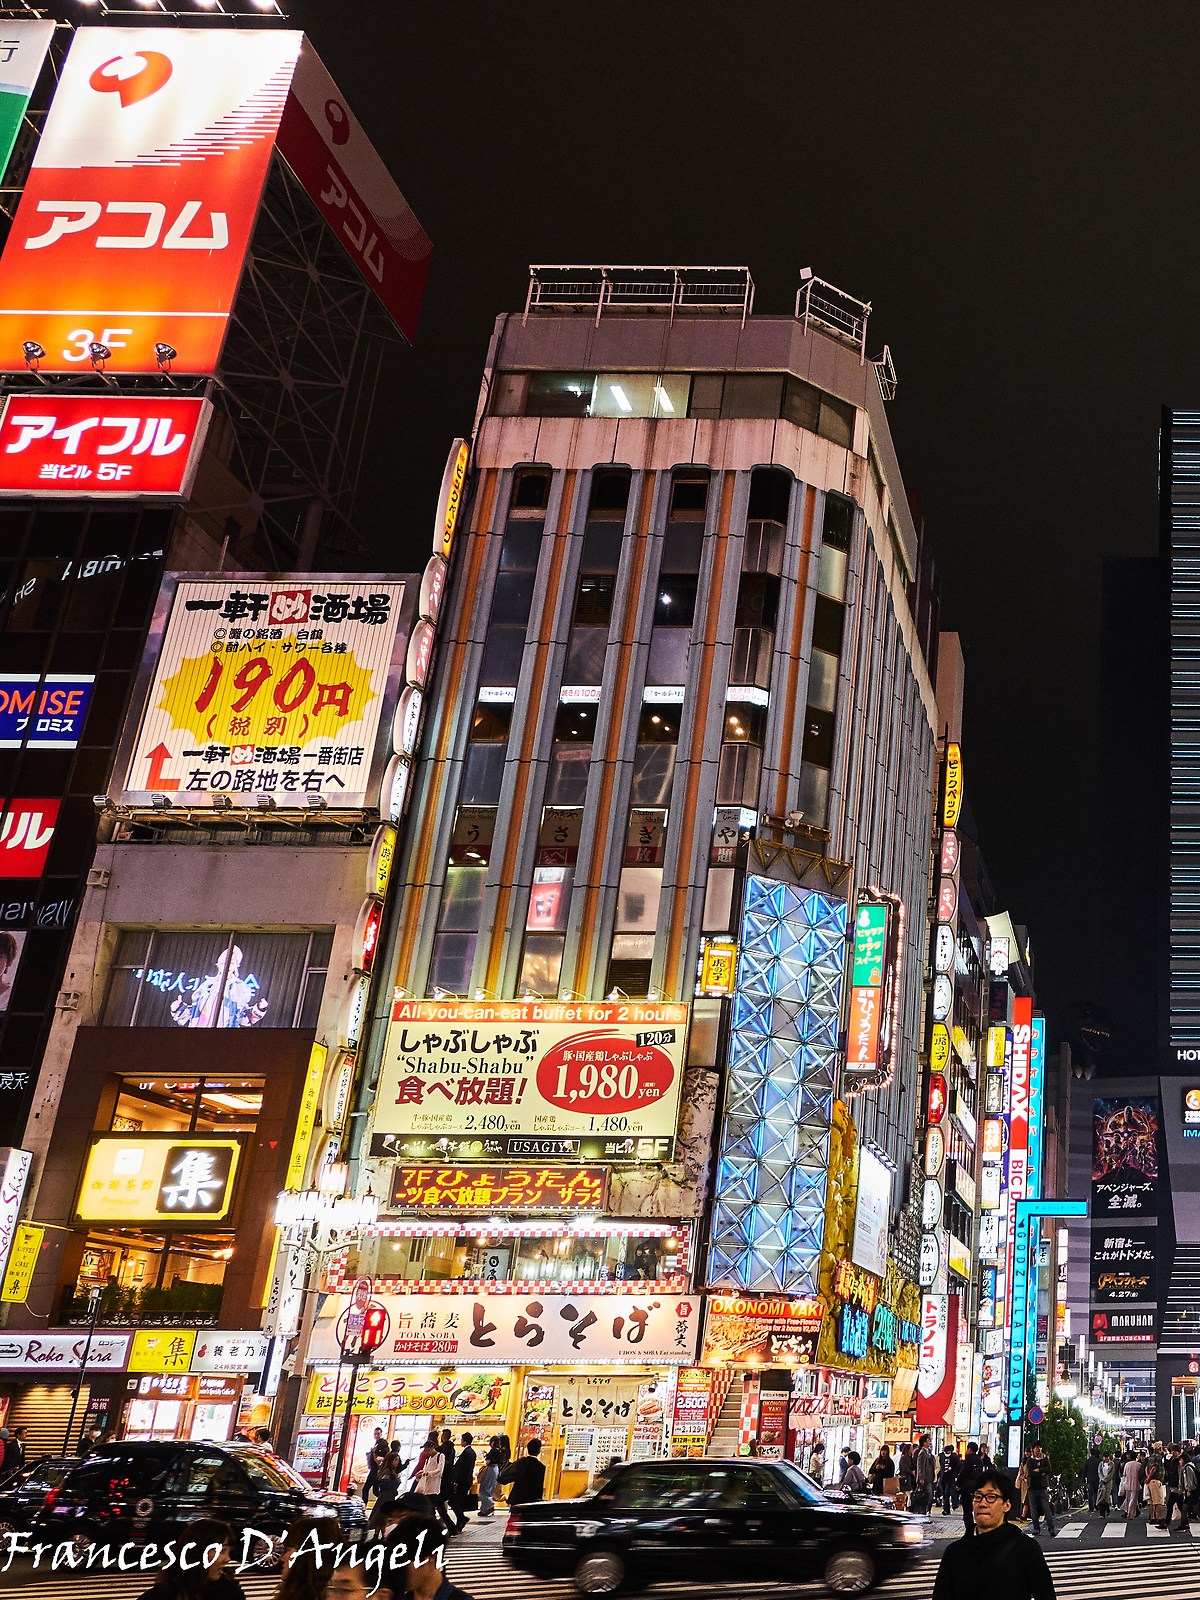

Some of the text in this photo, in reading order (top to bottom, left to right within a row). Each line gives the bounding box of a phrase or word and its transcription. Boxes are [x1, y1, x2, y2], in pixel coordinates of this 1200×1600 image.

[25, 200, 229, 251] アコム
[320, 163, 386, 285] アコム
[66, 328, 134, 362] 3F
[6, 415, 186, 457] アイフル
[39, 463, 132, 482] 当ビル 5F
[185, 588, 391, 627] 一軒め酒場
[195, 655, 354, 718] 190円
[0, 689, 84, 719] MISE
[185, 767, 346, 794] 左の路地を右へ
[398, 1004, 682, 1021] All-you-can-eat buffet for 2 hours
[399, 1028, 540, 1054] しゃぶしゃぶ
[638, 1031, 672, 1047] 120分
[551, 1063, 660, 1103] 1,980 yen
[1010, 1022, 1031, 1122] SHIDAX
[394, 1076, 528, 1106] 食べ放題!
[464, 1114, 506, 1132] 2,480
[588, 1115, 628, 1133] 1,480
[637, 1138, 669, 1157] 5F
[162, 1150, 223, 1209] 集
[401, 1169, 601, 1187] 7F ひょうたん
[1010, 1159, 1024, 1187] BIC
[398, 1311, 460, 1330] 旨蕎麦
[712, 1299, 824, 1318] OKONOMI YAKI
[1012, 1231, 1027, 1389] GODZILLA ROAD
[1110, 1315, 1153, 1327] MARUHAN
[398, 1331, 456, 1340] TORA SOBA
[469, 1300, 664, 1350] とらそば
[922, 1300, 938, 1358] トラノコ
[24, 1339, 112, 1367] Roko Sira
[164, 1335, 189, 1367] 集
[561, 1398, 636, 1419] とらそば
